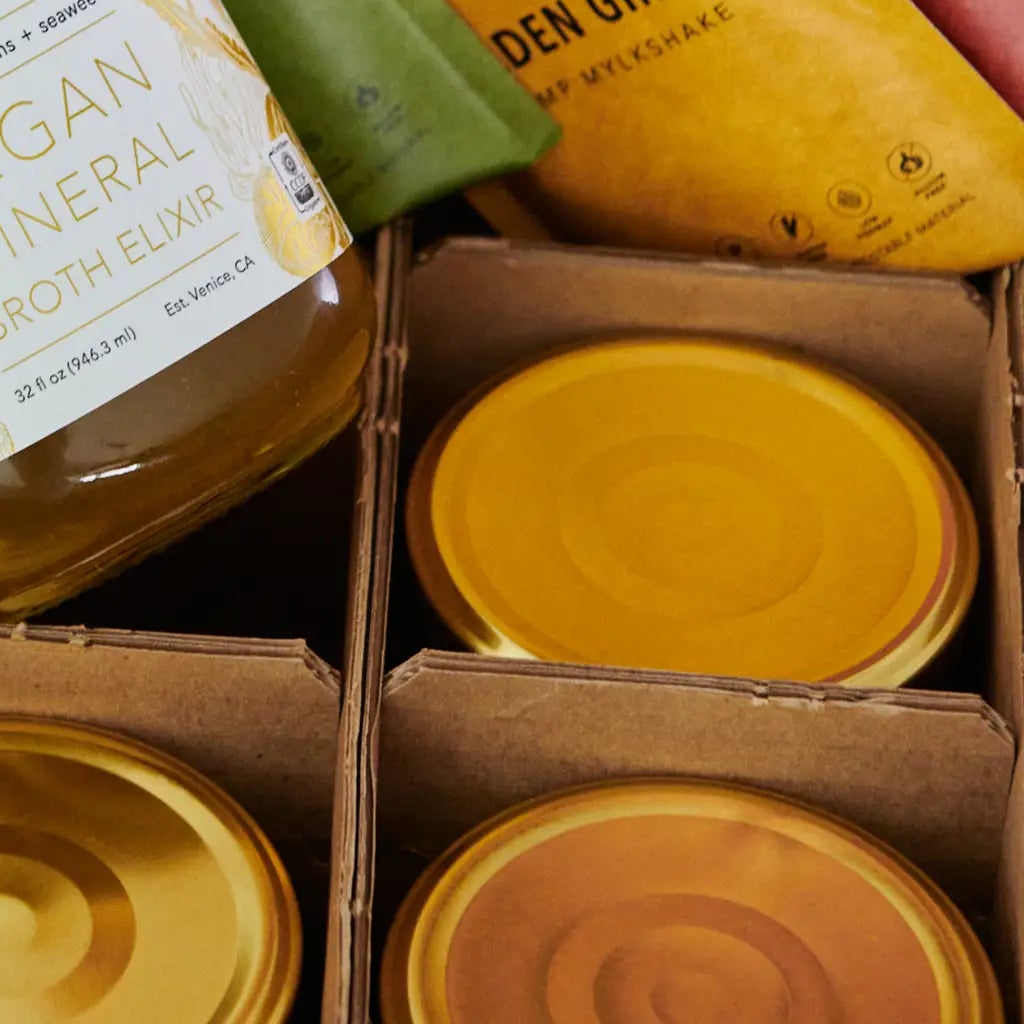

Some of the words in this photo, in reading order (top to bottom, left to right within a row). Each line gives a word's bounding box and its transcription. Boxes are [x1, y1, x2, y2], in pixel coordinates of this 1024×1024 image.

[579, 1, 735, 86] MYLKSHAKE
[115, 184, 224, 265] ELIXIR
[163, 298, 190, 318] Est.
[187, 271, 236, 303] Venice,
[233, 254, 257, 275] CA
[13, 385, 36, 404] 32
[35, 376, 48, 394] fl
[48, 369, 68, 386] oz
[66, 339, 113, 377] (946.3
[112, 325, 138, 350] ml)
